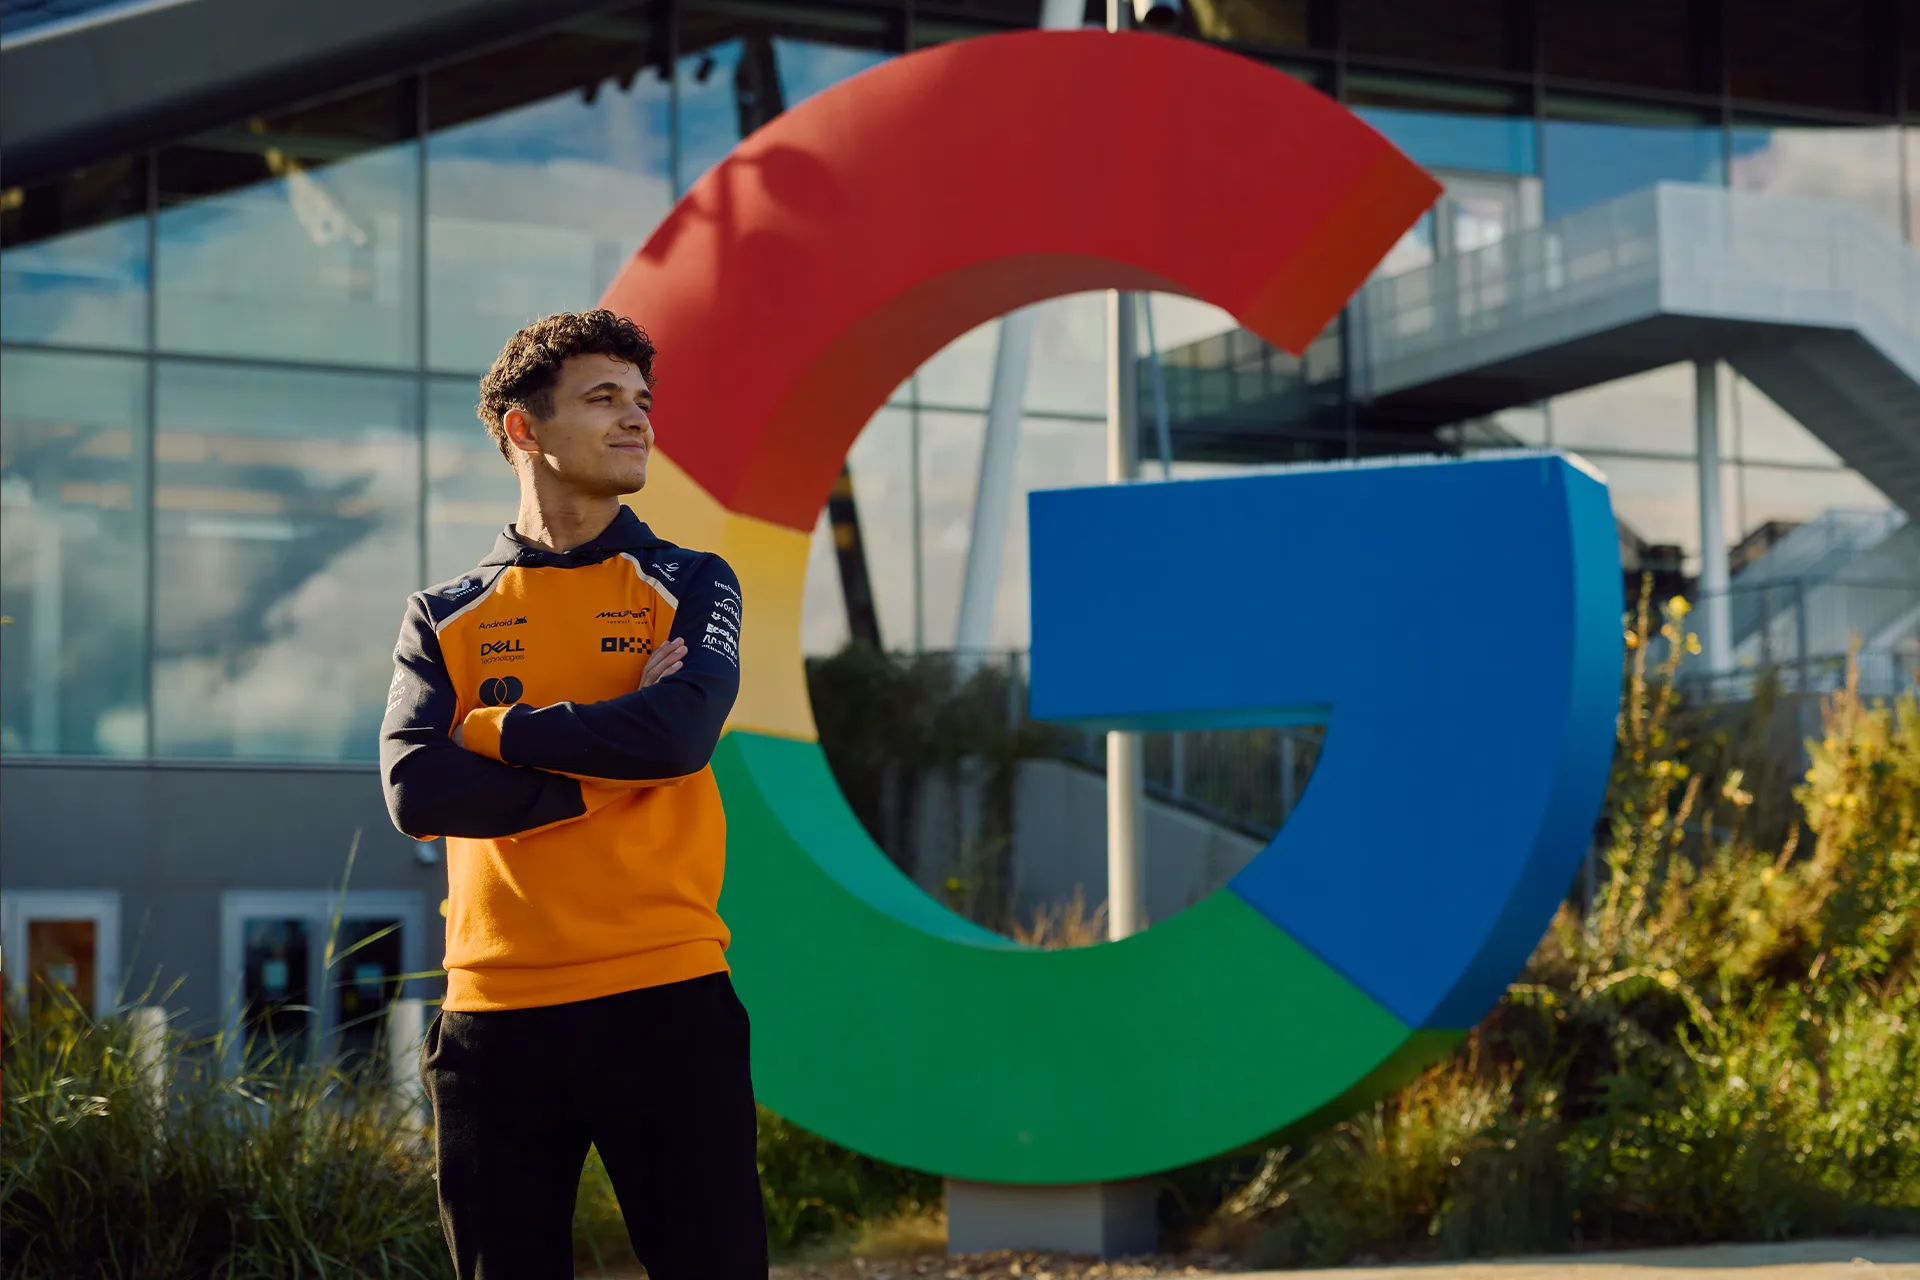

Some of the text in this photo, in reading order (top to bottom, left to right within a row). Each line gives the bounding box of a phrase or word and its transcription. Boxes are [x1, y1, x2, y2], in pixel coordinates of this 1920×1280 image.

[478, 618, 513, 630] Android
[480, 639, 525, 656] DELL
[480, 654, 525, 665] Technologies
